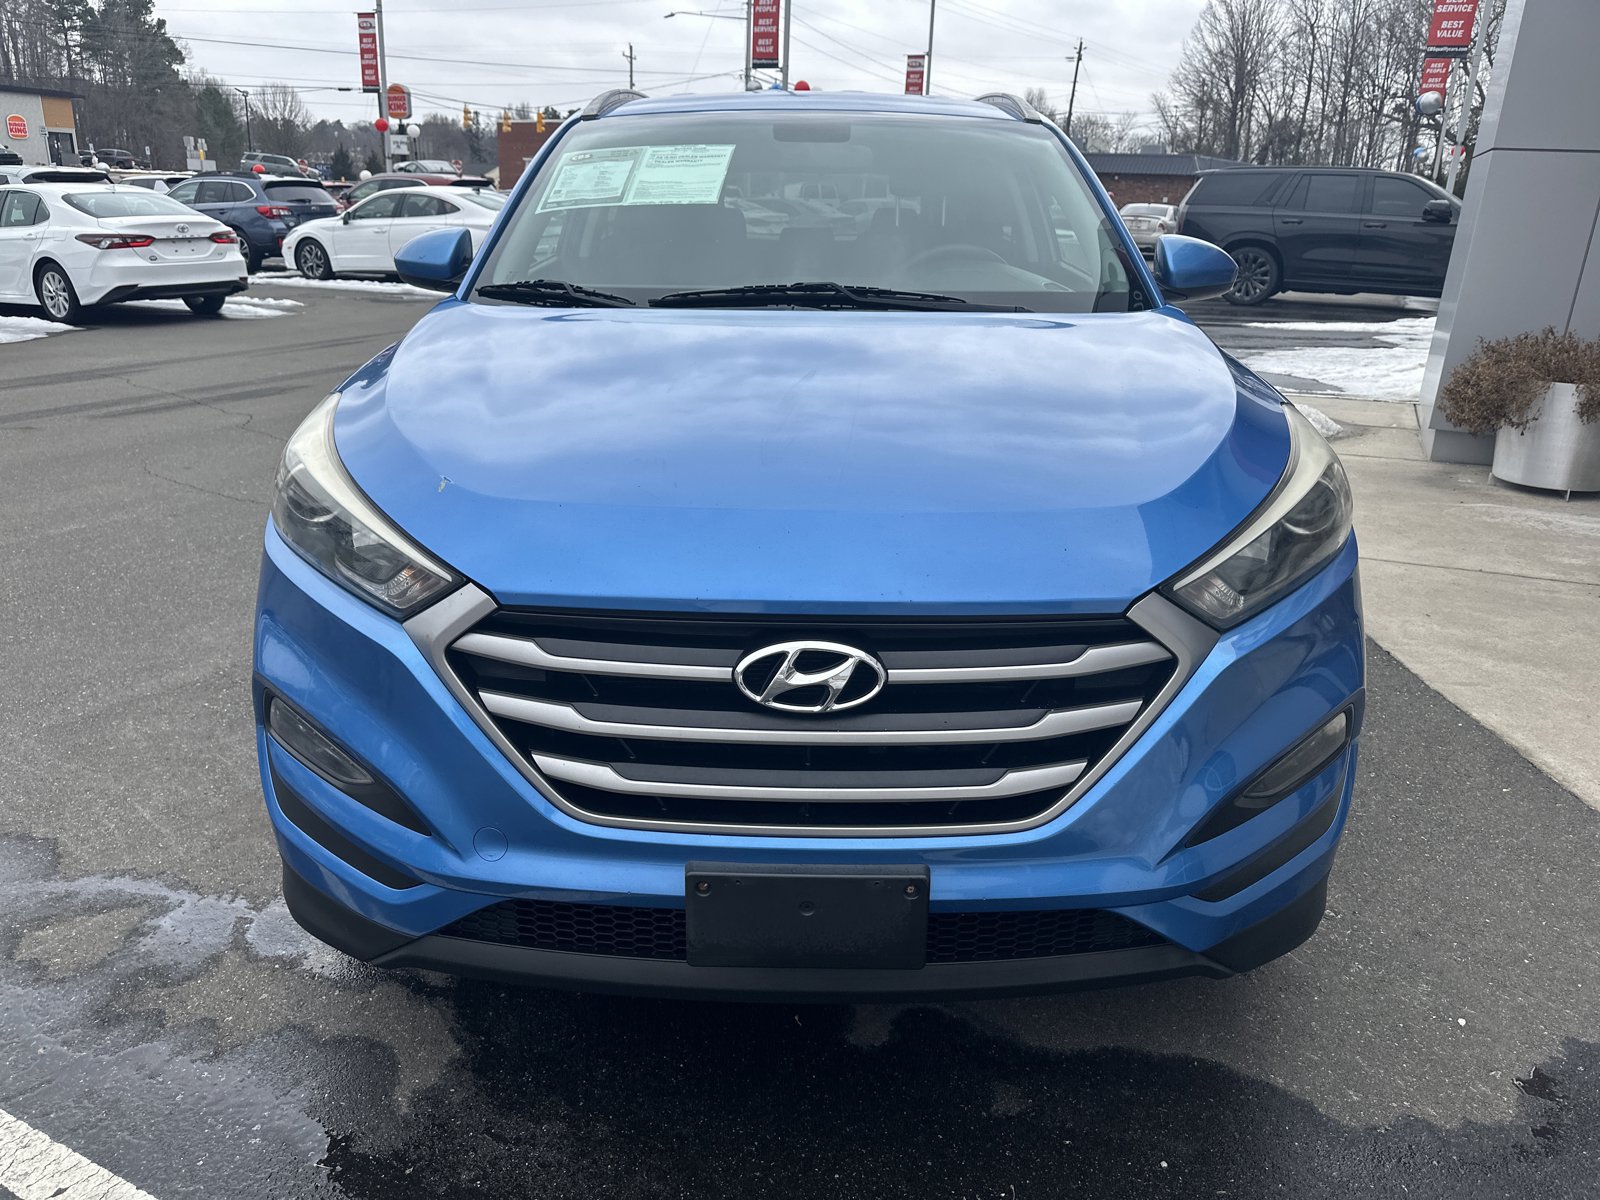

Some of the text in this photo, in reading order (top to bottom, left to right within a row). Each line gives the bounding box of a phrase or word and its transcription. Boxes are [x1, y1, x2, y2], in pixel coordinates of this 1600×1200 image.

[1436, 4, 1474, 12] SERVICE
[1441, 20, 1464, 29] BEST
[1436, 29, 1464, 38] VALUE
[756, 45, 774, 53] VALUE
[388, 102, 406, 111] KING
[9, 127, 28, 135] KING
